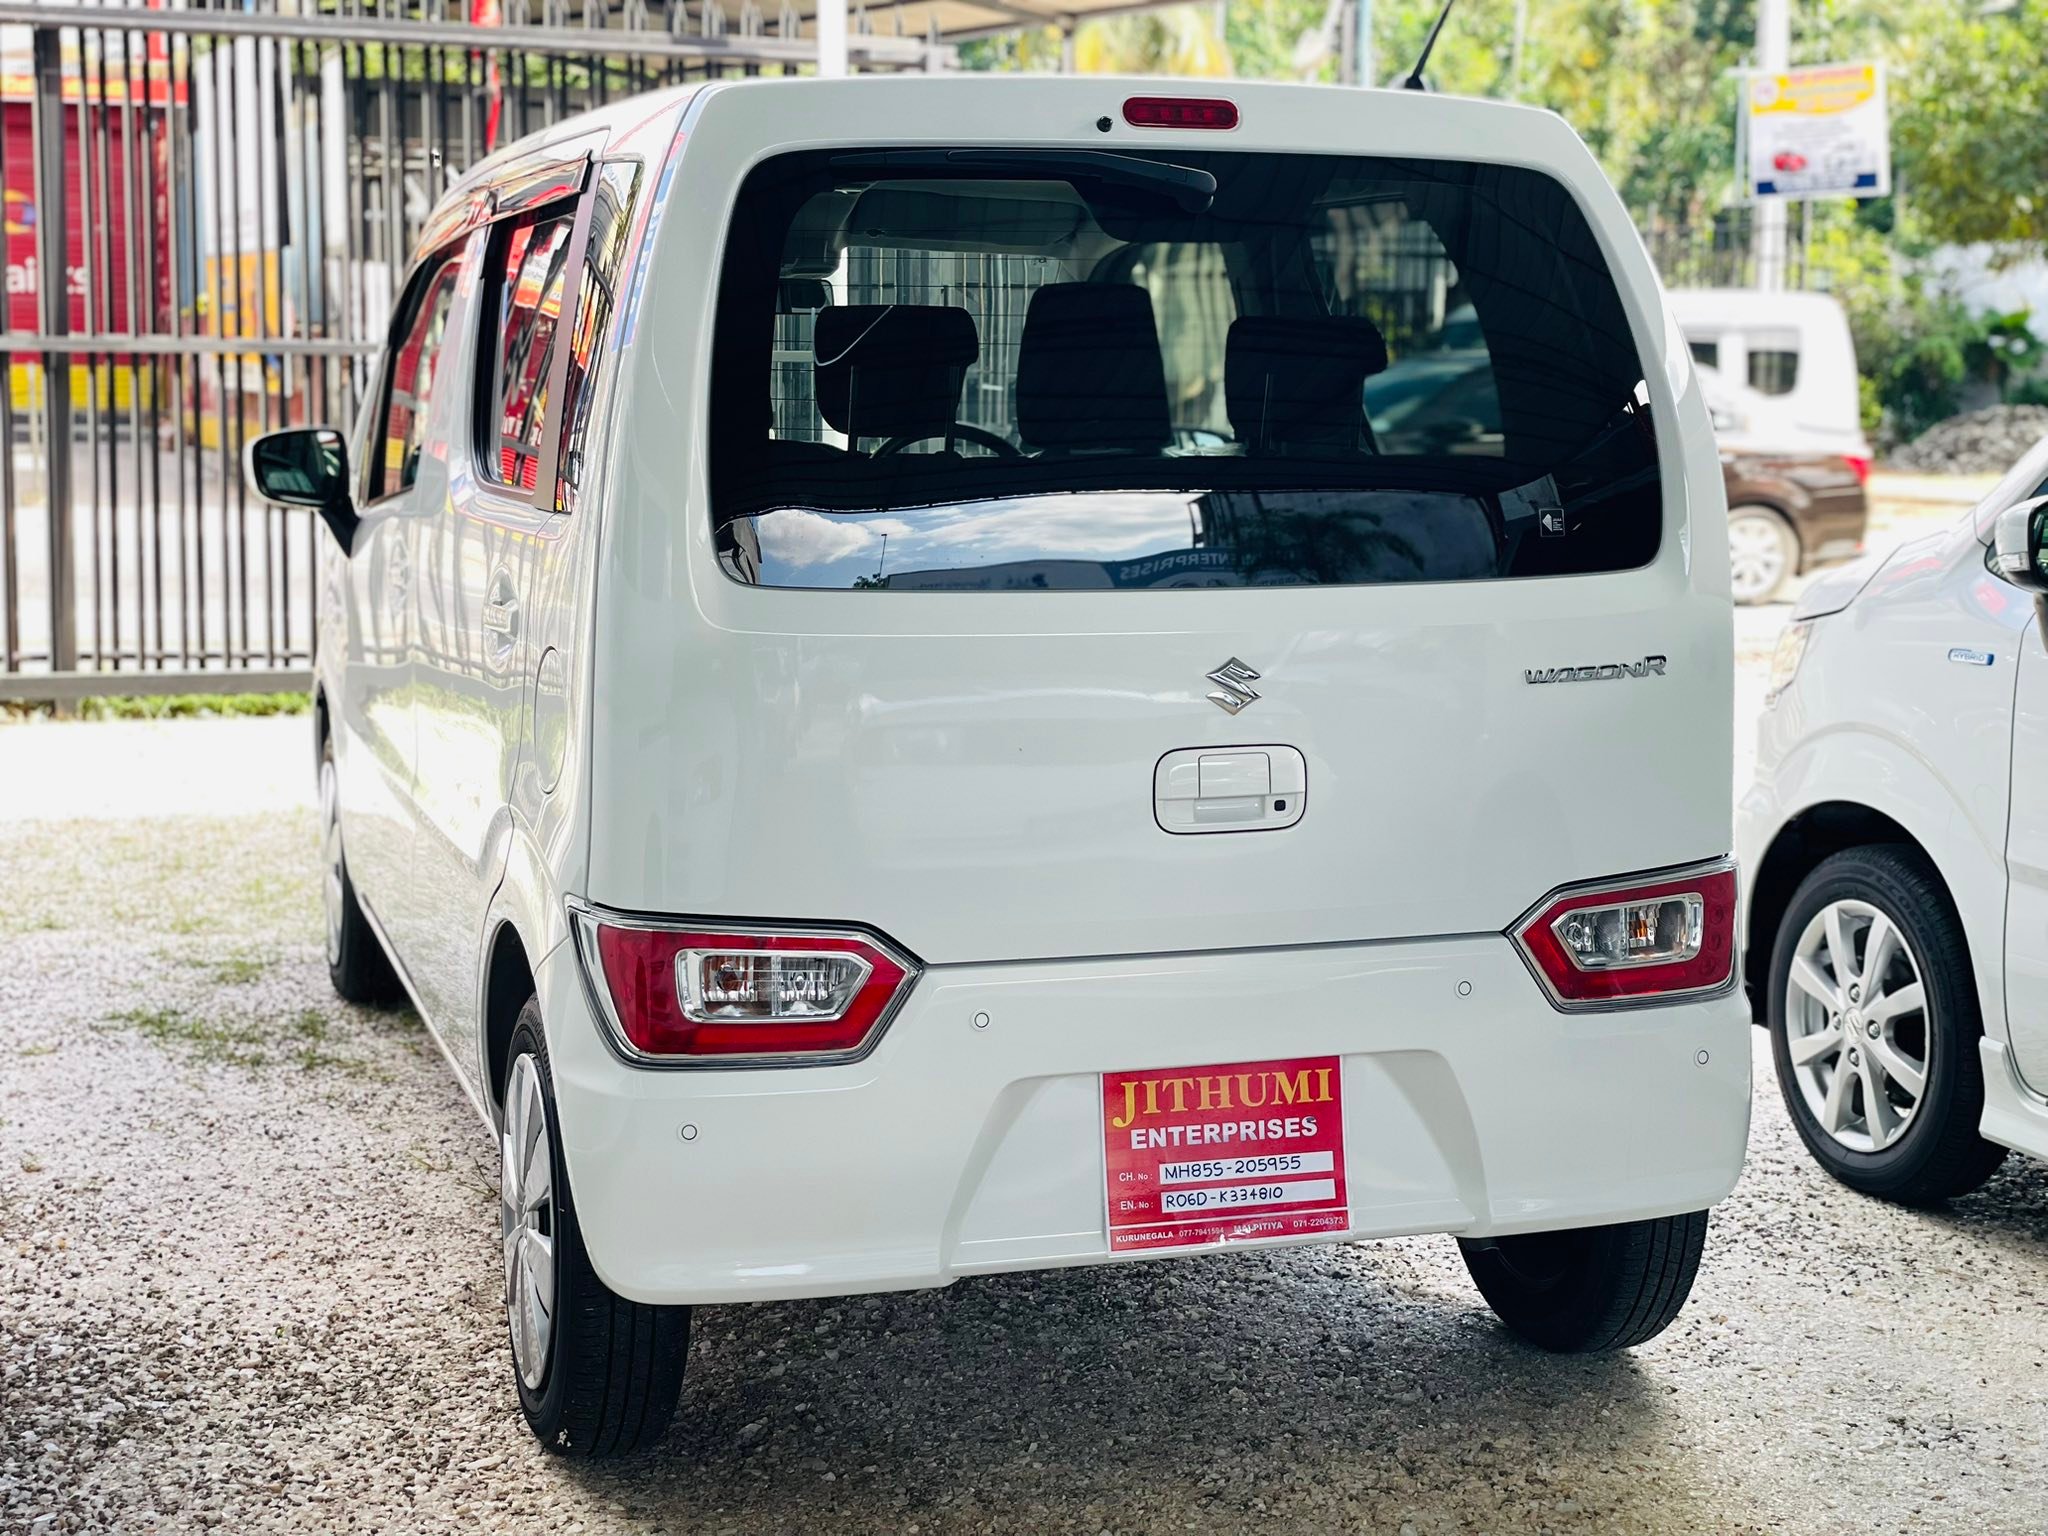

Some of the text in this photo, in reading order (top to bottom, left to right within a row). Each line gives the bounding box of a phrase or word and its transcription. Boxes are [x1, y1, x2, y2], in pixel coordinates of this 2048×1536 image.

[1953, 652, 1985, 662] HYBRID
[1112, 1068, 1334, 1128] JITHUMI
[1130, 1116, 1318, 1150] ENTERPRISES
[1119, 1172, 1136, 1182] CH.
[1165, 1155, 1301, 1179] MH85S-205955
[1120, 1200, 1137, 1210] EN.
[1116, 1230, 1174, 1243] KURUNEGALA
[1293, 1216, 1344, 1228] 071-2204373
